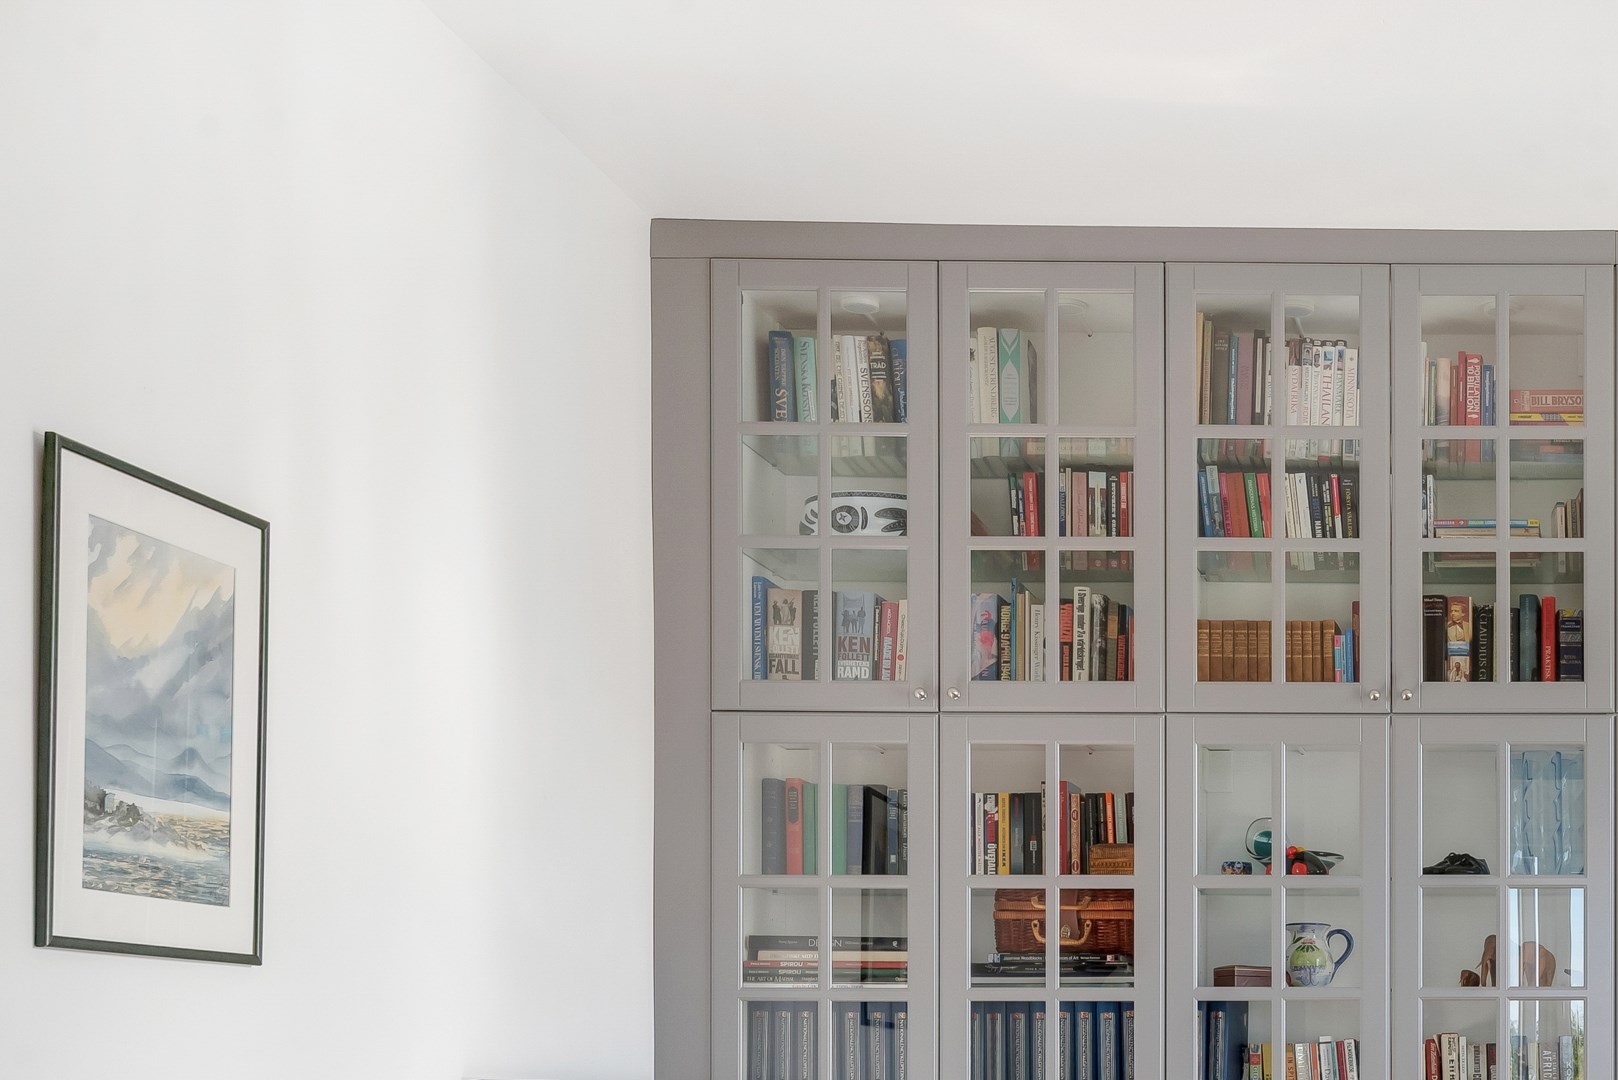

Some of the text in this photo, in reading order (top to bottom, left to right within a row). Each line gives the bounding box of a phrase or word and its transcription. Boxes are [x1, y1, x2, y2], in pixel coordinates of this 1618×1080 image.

[800, 341, 810, 382] SVENSKA
[1467, 366, 1474, 375] 10
[990, 368, 998, 418] STRINDBERG
[1290, 368, 1299, 414] SYDAFRIKA
[1334, 374, 1343, 414] DANMARK
[1346, 368, 1355, 419] MINNESOTA
[1531, 395, 1583, 406] BILL BRYSO
[775, 388, 788, 422] SVE
[1076, 593, 1087, 614] Sverige
[1000, 605, 1011, 632] NORGE
[1033, 609, 1042, 629] Henry
[837, 636, 870, 653] KEN
[1001, 640, 1011, 663] APRIL
[1033, 631, 1042, 661] Kissinger
[1478, 614, 1488, 667] CLAUDIUS
[769, 659, 801, 675] FALL
[837, 653, 870, 661] FOLLETT
[837, 666, 870, 680] RAND
[1001, 663, 1011, 681] 1940
